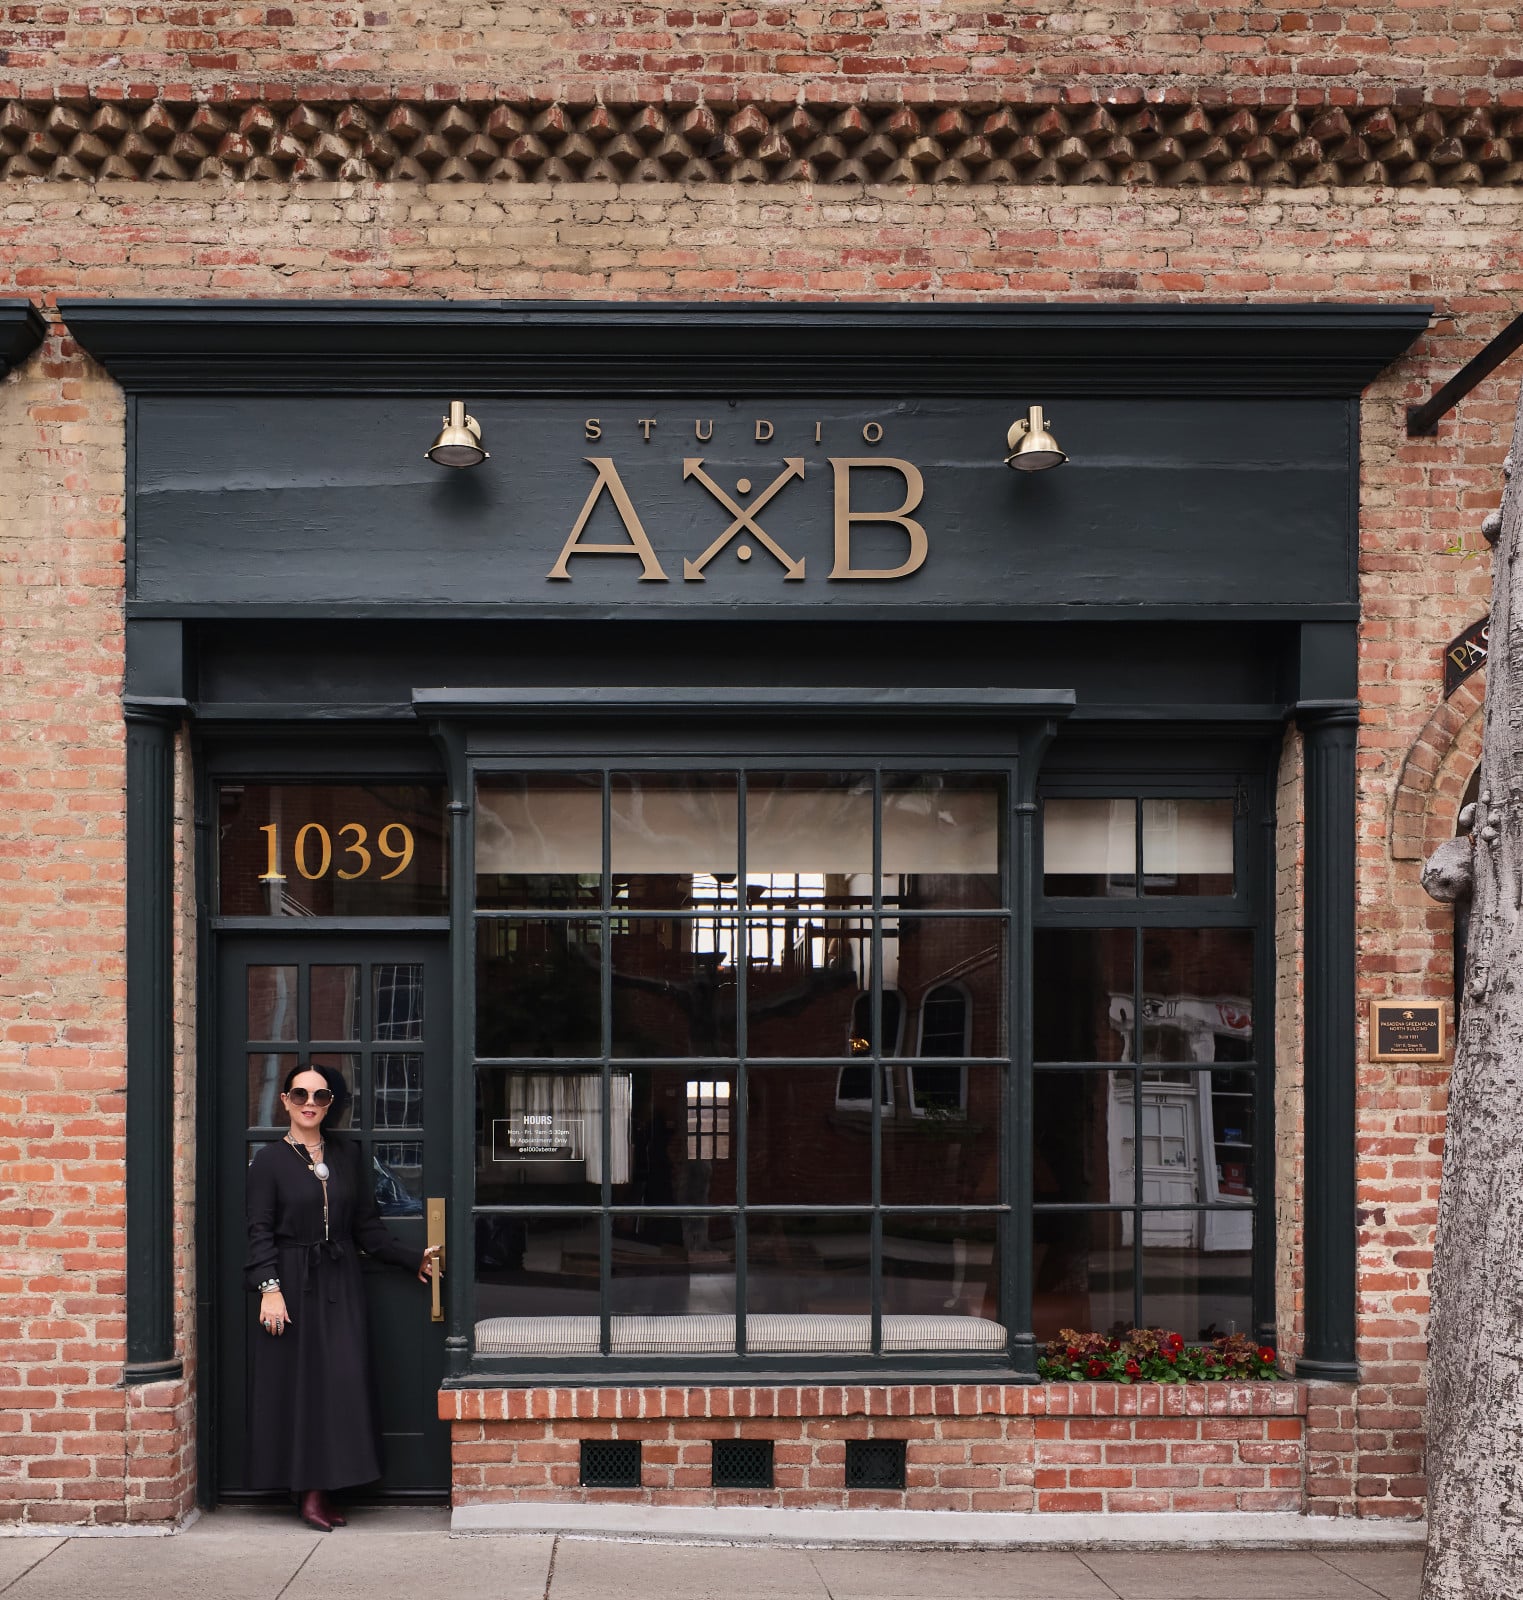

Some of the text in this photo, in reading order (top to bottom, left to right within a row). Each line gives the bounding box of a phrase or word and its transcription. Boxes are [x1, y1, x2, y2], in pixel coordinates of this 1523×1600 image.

[584, 418, 884, 443] STUDIO
[257, 822, 415, 880] 1039
[524, 1116, 552, 1124] HOURS
